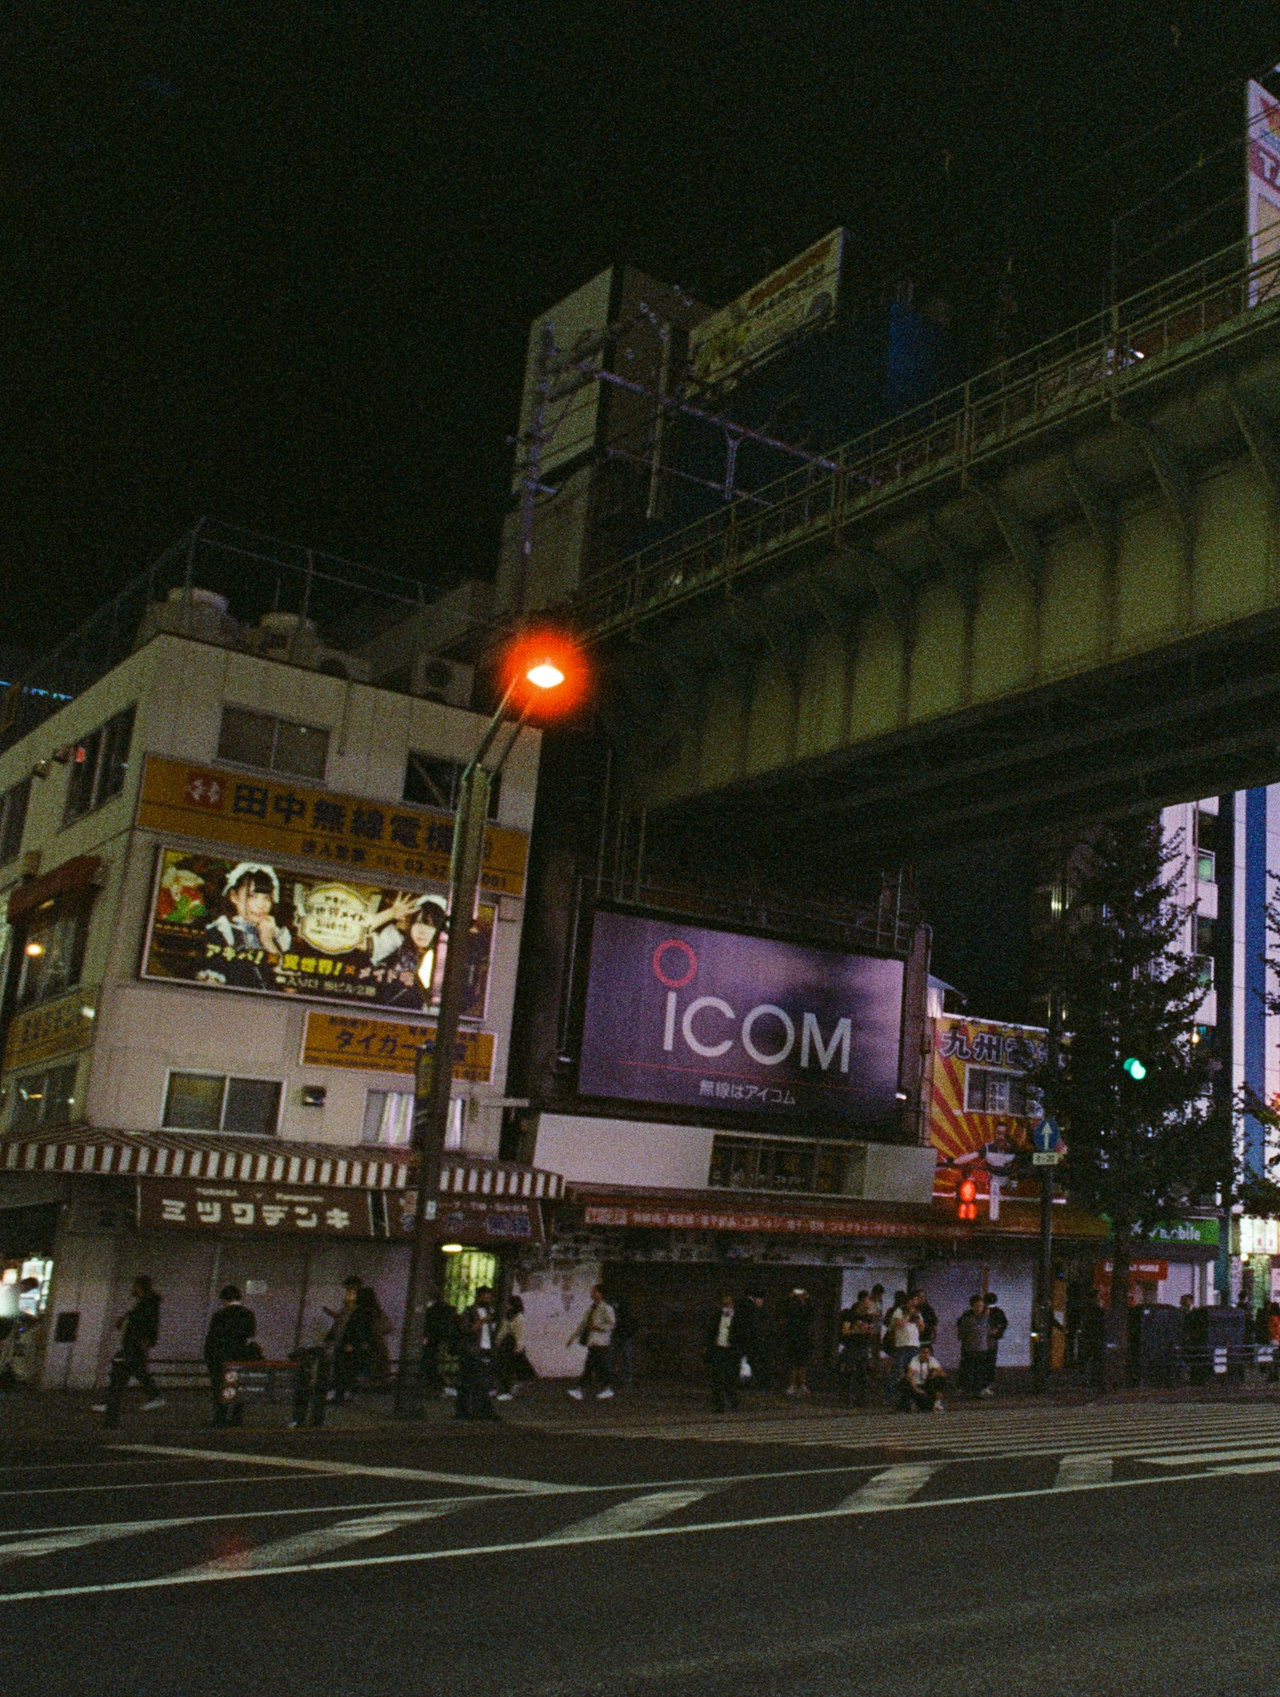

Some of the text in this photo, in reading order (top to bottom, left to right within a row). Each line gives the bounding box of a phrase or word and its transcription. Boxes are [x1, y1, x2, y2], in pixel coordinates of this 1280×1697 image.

[698, 1079, 797, 1106] 無線はアイコム
[160, 1197, 351, 1231] ミツワデンキ
